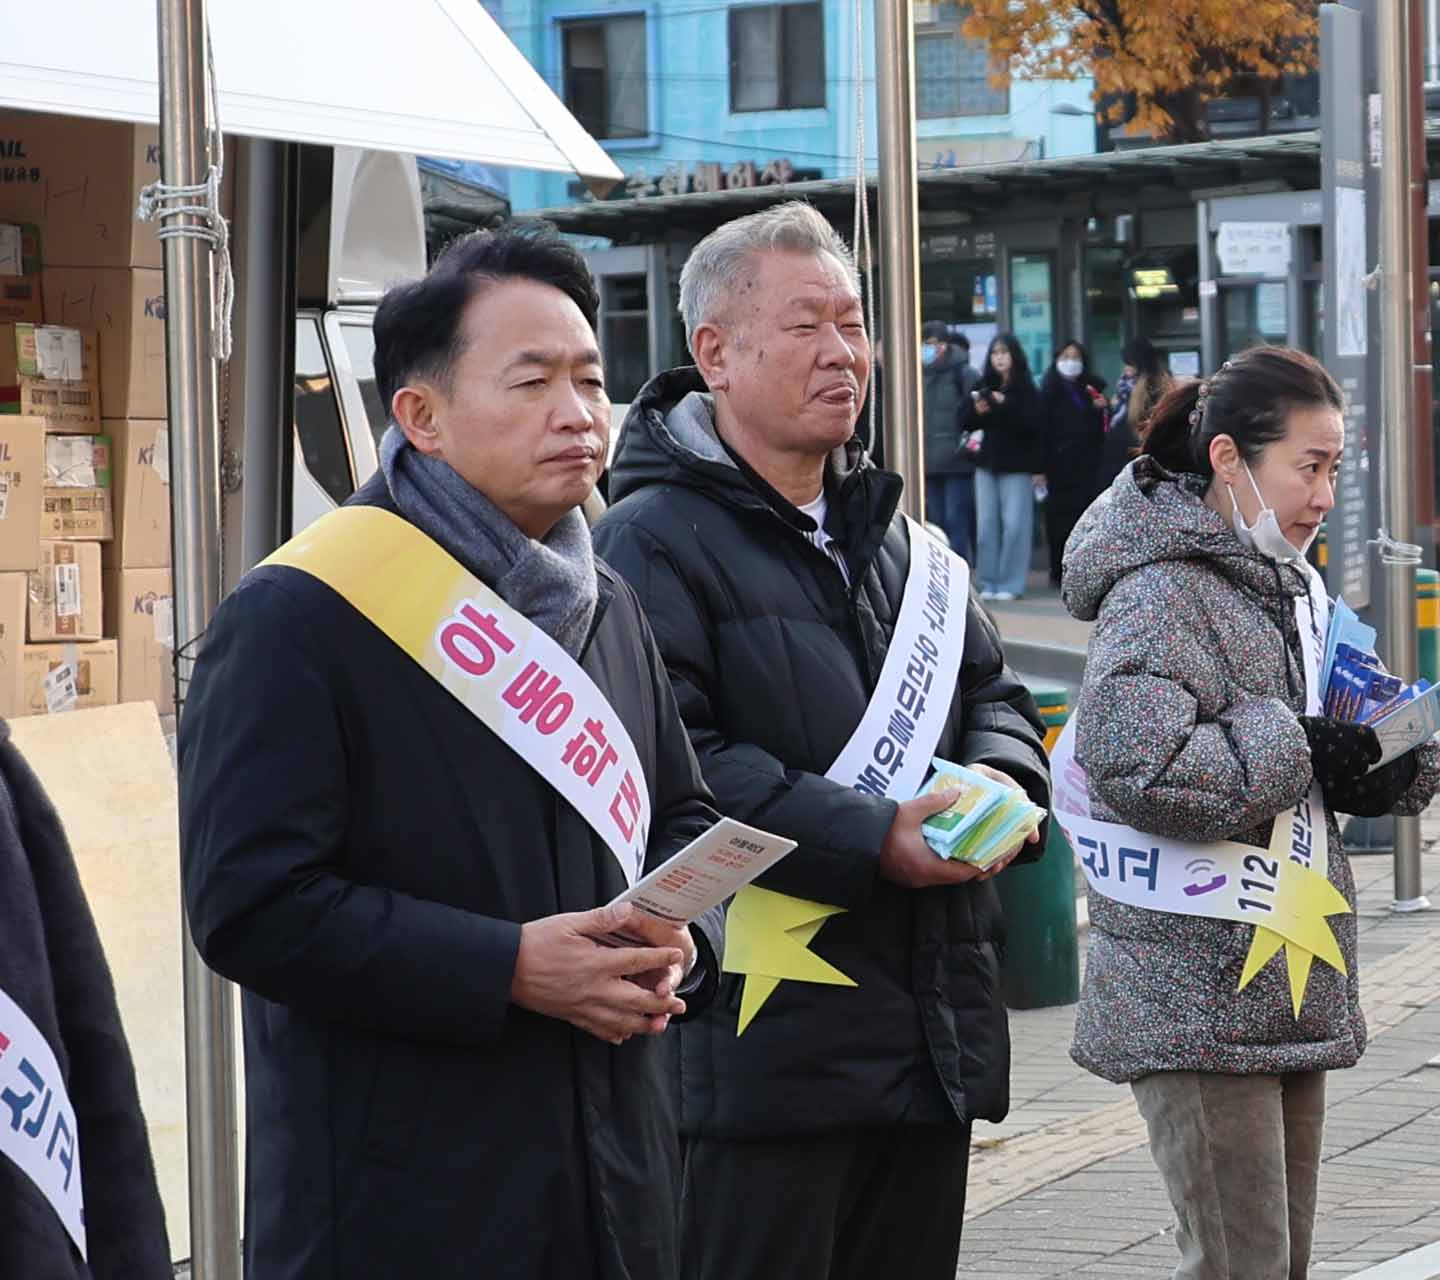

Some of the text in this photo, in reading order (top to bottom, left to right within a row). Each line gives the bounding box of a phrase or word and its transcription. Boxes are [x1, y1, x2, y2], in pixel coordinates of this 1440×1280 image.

[440, 603, 642, 844] 아동학대
[1077, 835, 1279, 913] 신고 112
[0, 1057, 75, 1193] 신고
